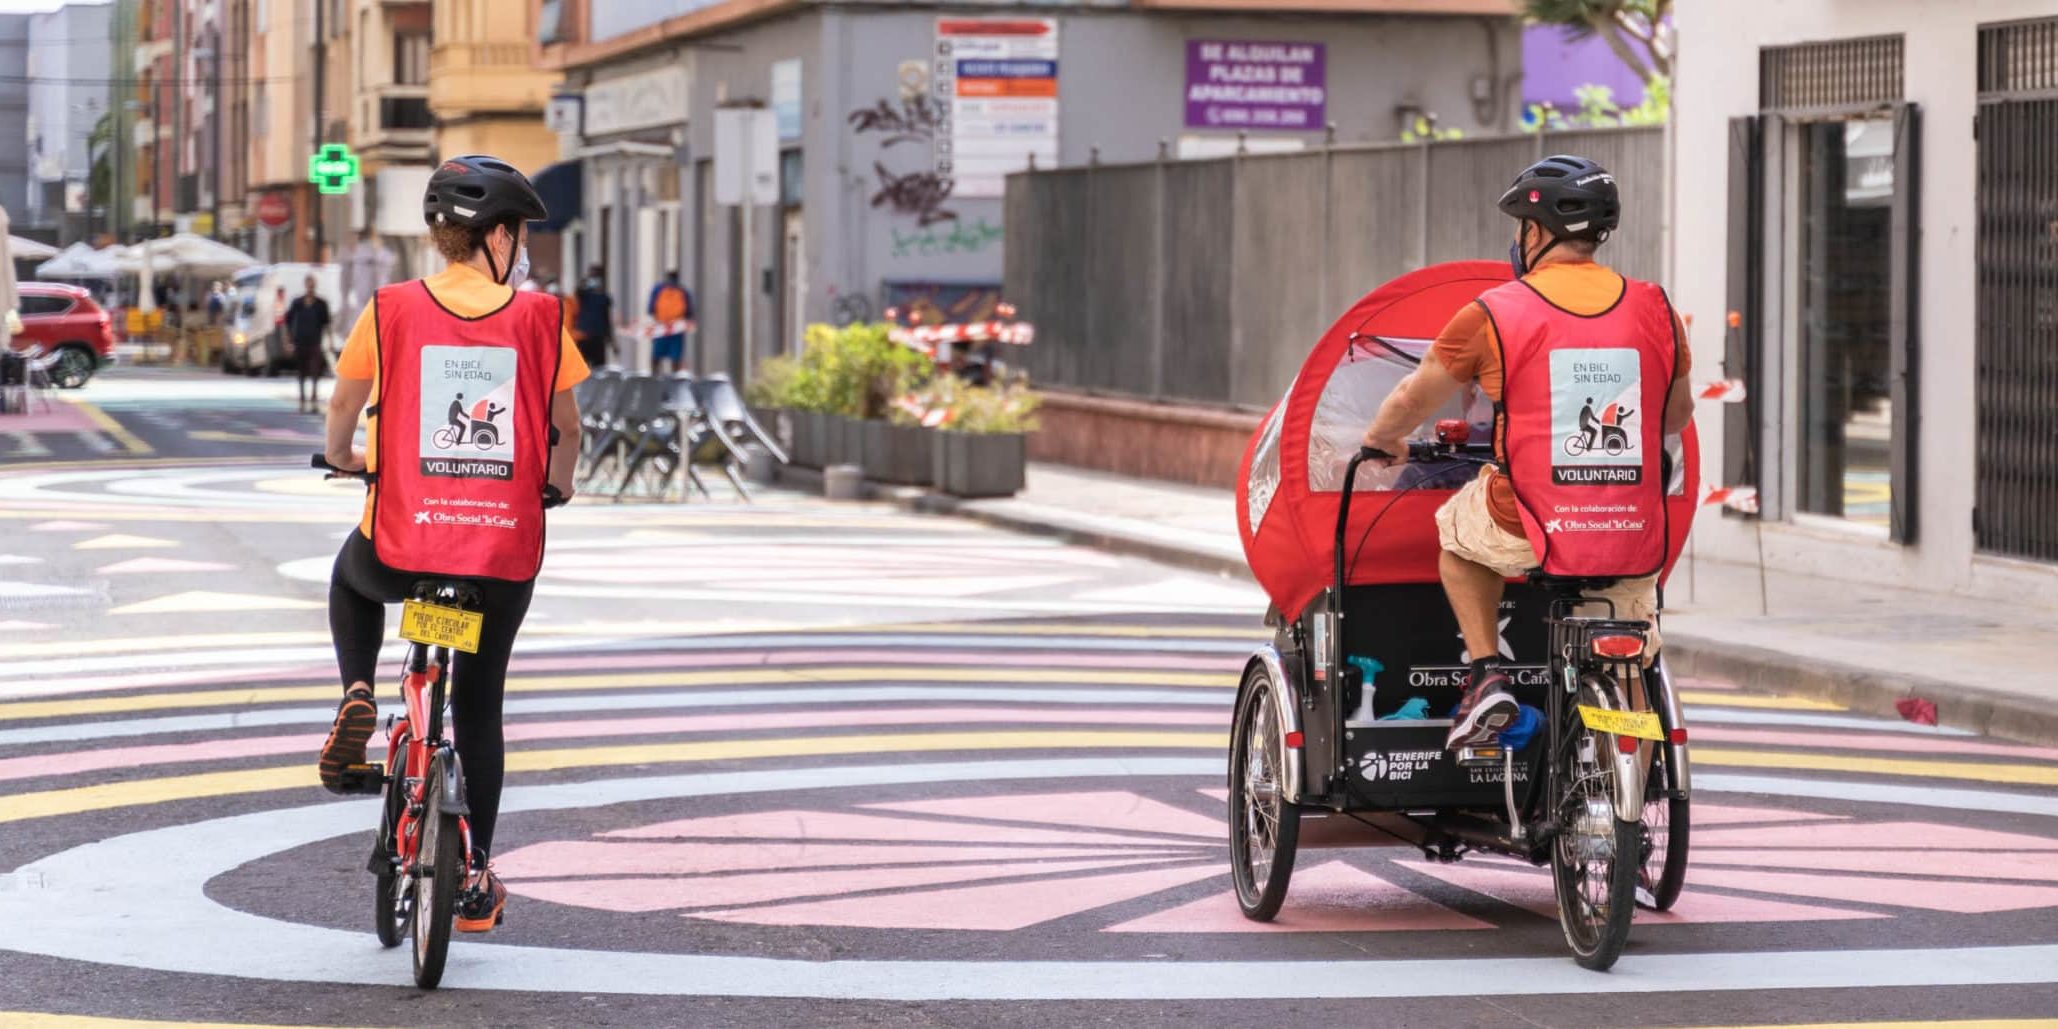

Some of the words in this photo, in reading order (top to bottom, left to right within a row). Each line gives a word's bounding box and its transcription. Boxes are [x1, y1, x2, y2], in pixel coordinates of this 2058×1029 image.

[1201, 44, 1222, 61] SE
[1227, 44, 1314, 62] ALQUILAN
[1208, 64, 1277, 82] PLAZAS
[1279, 65, 1303, 83] DE
[1189, 84, 1324, 105] APARCAMIENTO
[444, 360, 459, 369] EN
[461, 360, 482, 370] BICI
[1573, 363, 1587, 372] EN
[1589, 363, 1608, 372] BICI
[444, 369, 462, 380] SIN
[464, 370, 492, 382] EDAD
[1574, 374, 1591, 383] SIN
[1593, 374, 1621, 383] EDAD
[426, 461, 508, 476] VOLUNTARIO
[1558, 469, 1637, 481] VOLUNTARIO
[440, 498, 448, 506] la
[449, 498, 497, 508] colaboración
[1554, 505, 1570, 513] Con
[1571, 505, 1579, 513] la
[1580, 504, 1626, 513] colaboración
[433, 512, 455, 521] Obra
[456, 513, 481, 523] Social
[1564, 520, 1586, 529] Obra
[1588, 520, 1611, 529] Social
[1409, 671, 1448, 687] Obra
[1389, 751, 1442, 761] TENERIFE
[1389, 761, 1413, 770] POR
[1415, 761, 1428, 770] LA
[1389, 771, 1411, 780] BICI
[1471, 774, 1484, 783] LA
[1486, 772, 1528, 783] LAGNA
